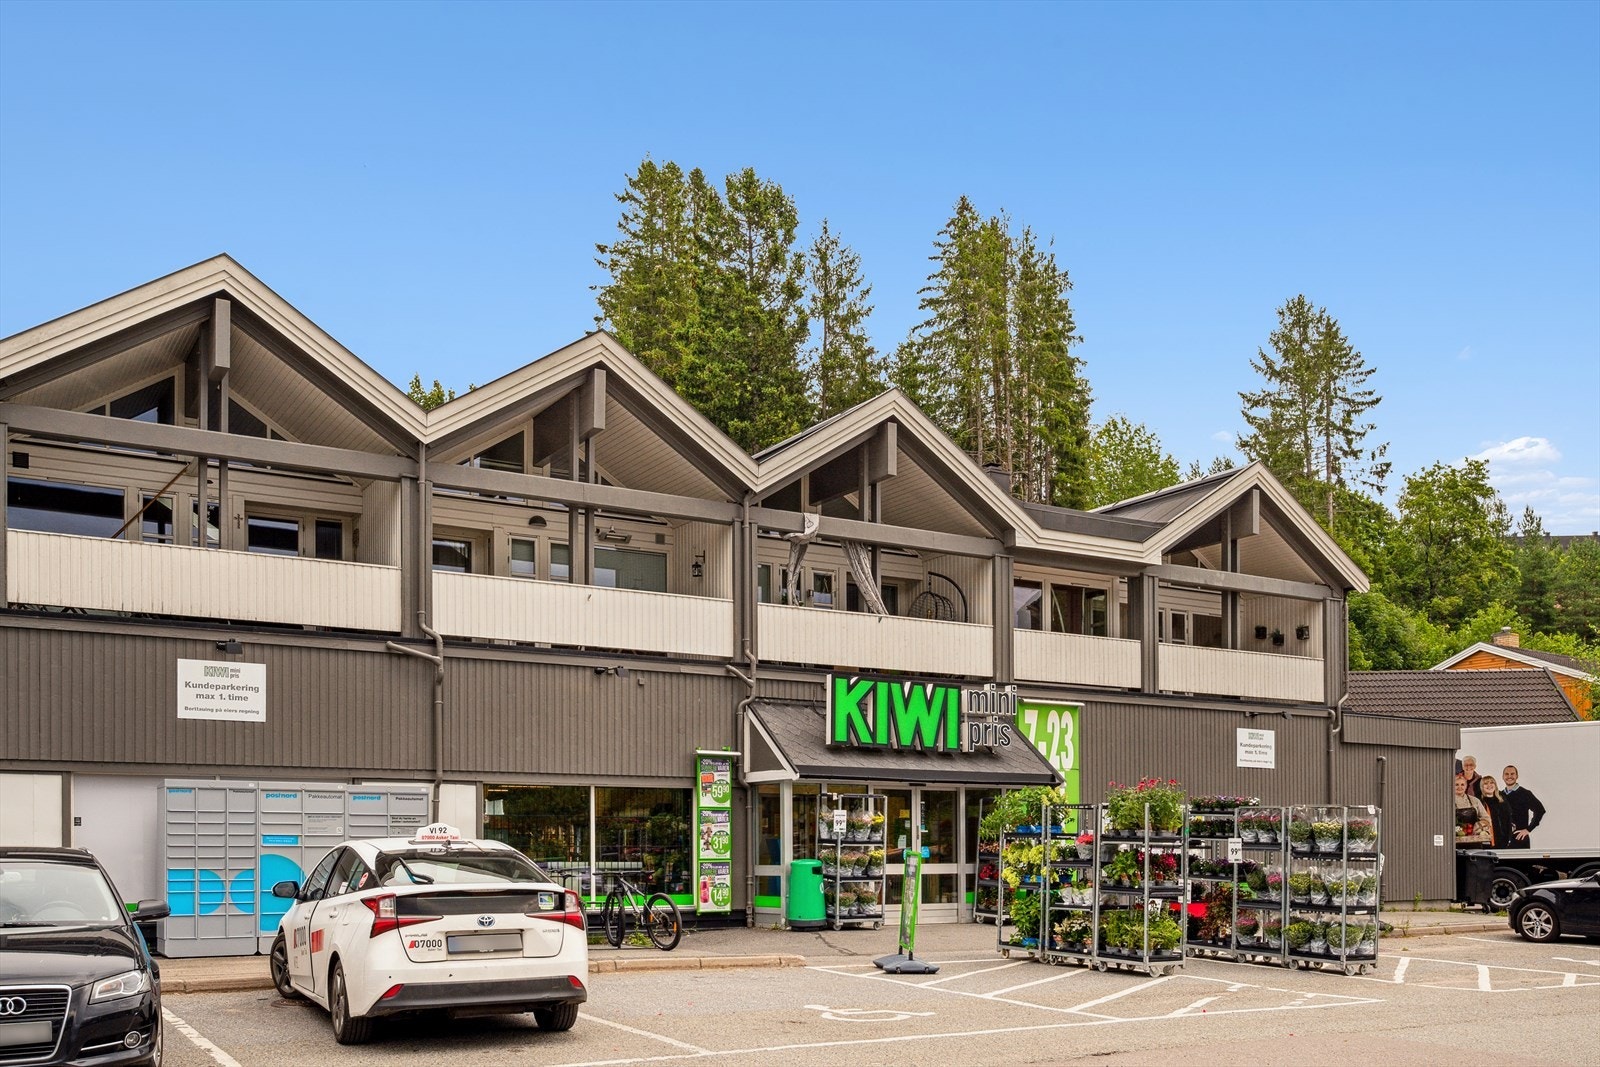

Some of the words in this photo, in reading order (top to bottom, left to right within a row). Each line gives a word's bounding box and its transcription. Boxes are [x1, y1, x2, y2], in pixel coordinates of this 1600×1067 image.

[204, 665, 229, 678] KIWI
[184, 681, 260, 693] Kundeparkering
[228, 693, 249, 701] time
[831, 675, 961, 751] KIWI
[968, 683, 1018, 715] mini
[968, 715, 1011, 752] pris
[438, 826, 448, 834] 92
[414, 939, 442, 948] 07000
